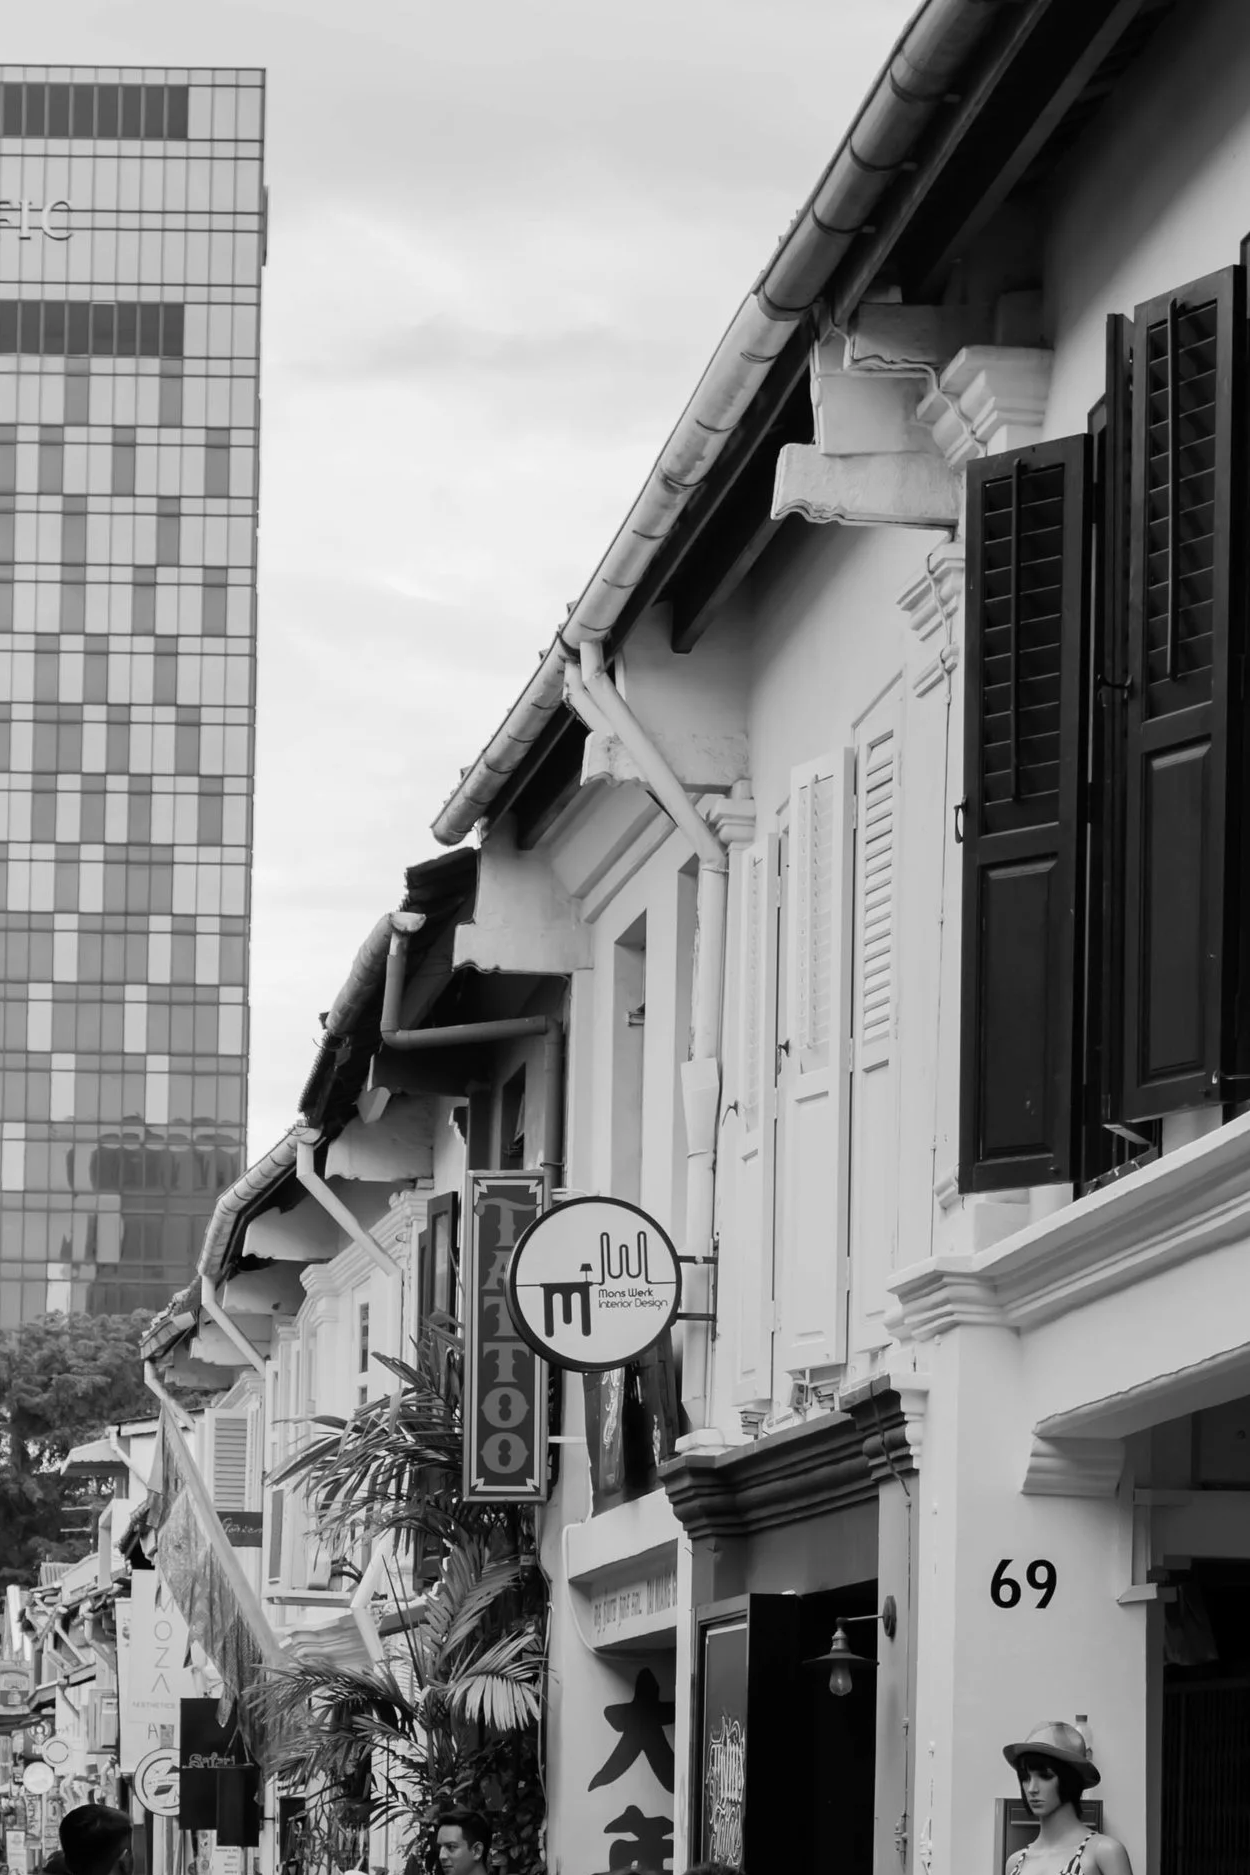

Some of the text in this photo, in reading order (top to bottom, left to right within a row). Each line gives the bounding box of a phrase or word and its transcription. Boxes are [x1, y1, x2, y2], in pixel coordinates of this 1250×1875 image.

[598, 1287, 654, 1298] Mons Werk
[598, 1297, 669, 1311] Interior Design
[474, 1197, 543, 1475] TATTOO
[990, 1558, 1058, 1609] 69
